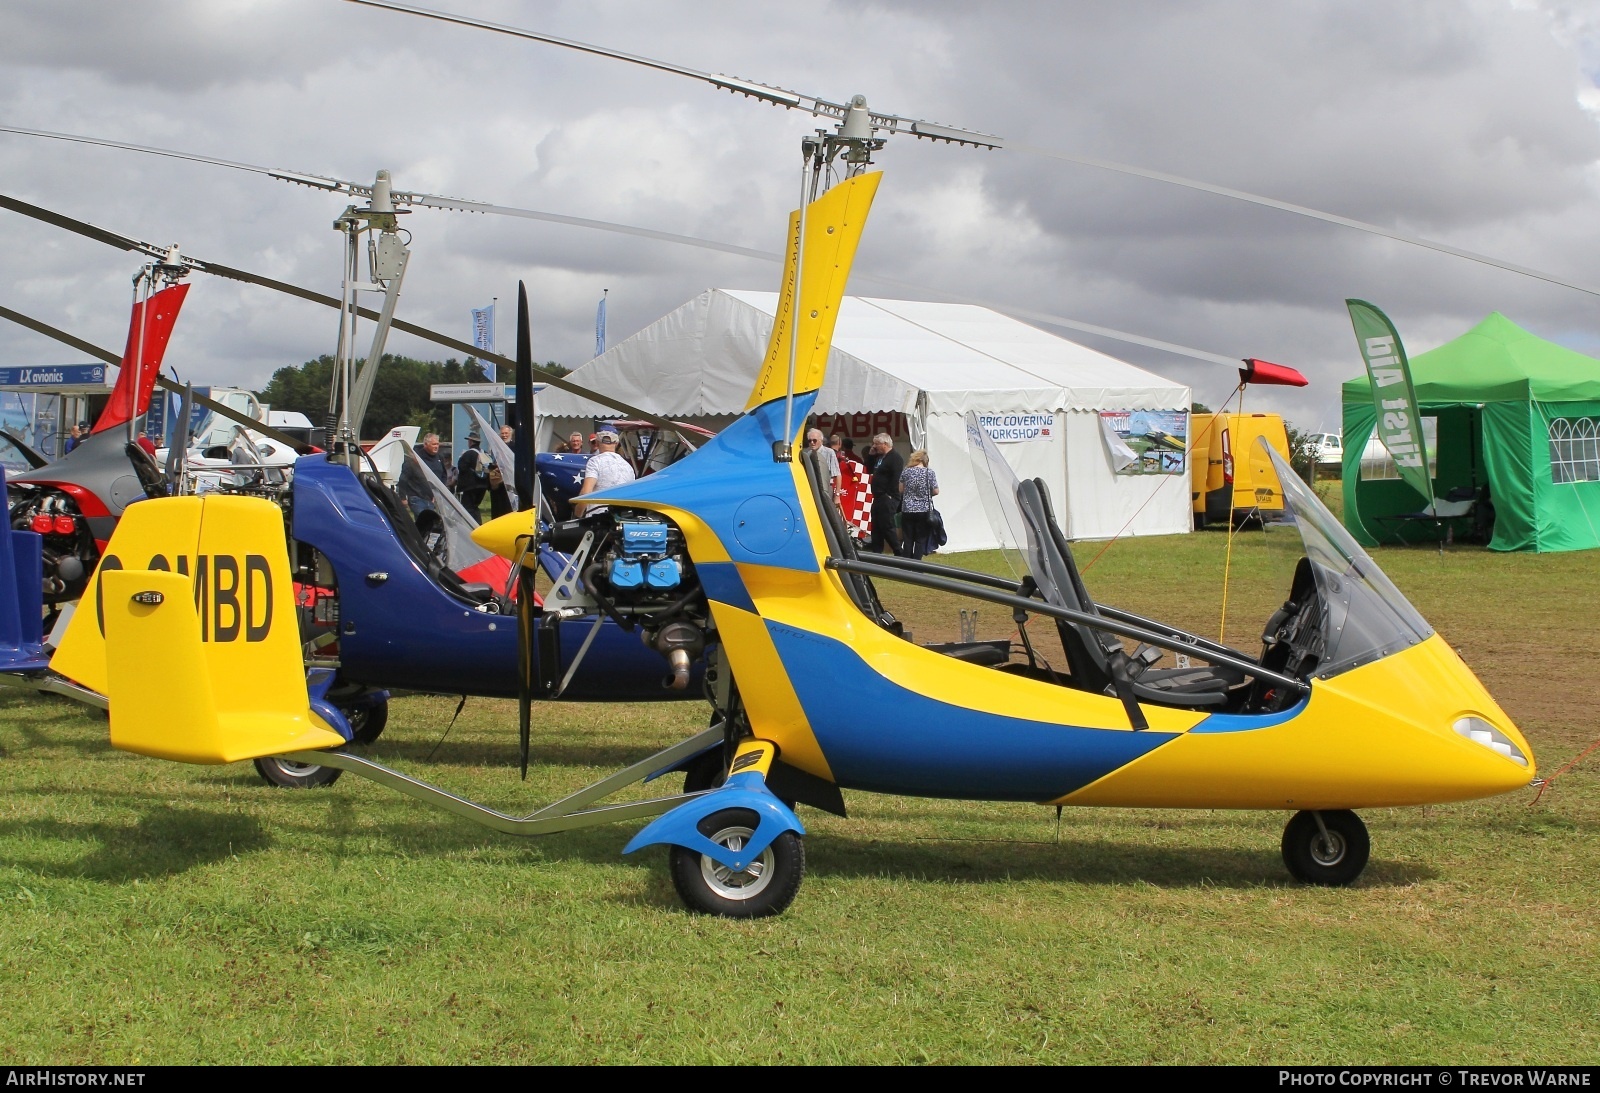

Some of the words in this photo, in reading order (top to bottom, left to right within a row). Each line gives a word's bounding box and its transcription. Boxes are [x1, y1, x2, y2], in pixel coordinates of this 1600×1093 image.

[20, 369, 33, 384] LX
[32, 368, 64, 383] avionics
[980, 416, 1002, 427] BRIC
[1003, 415, 1053, 427] COVERING
